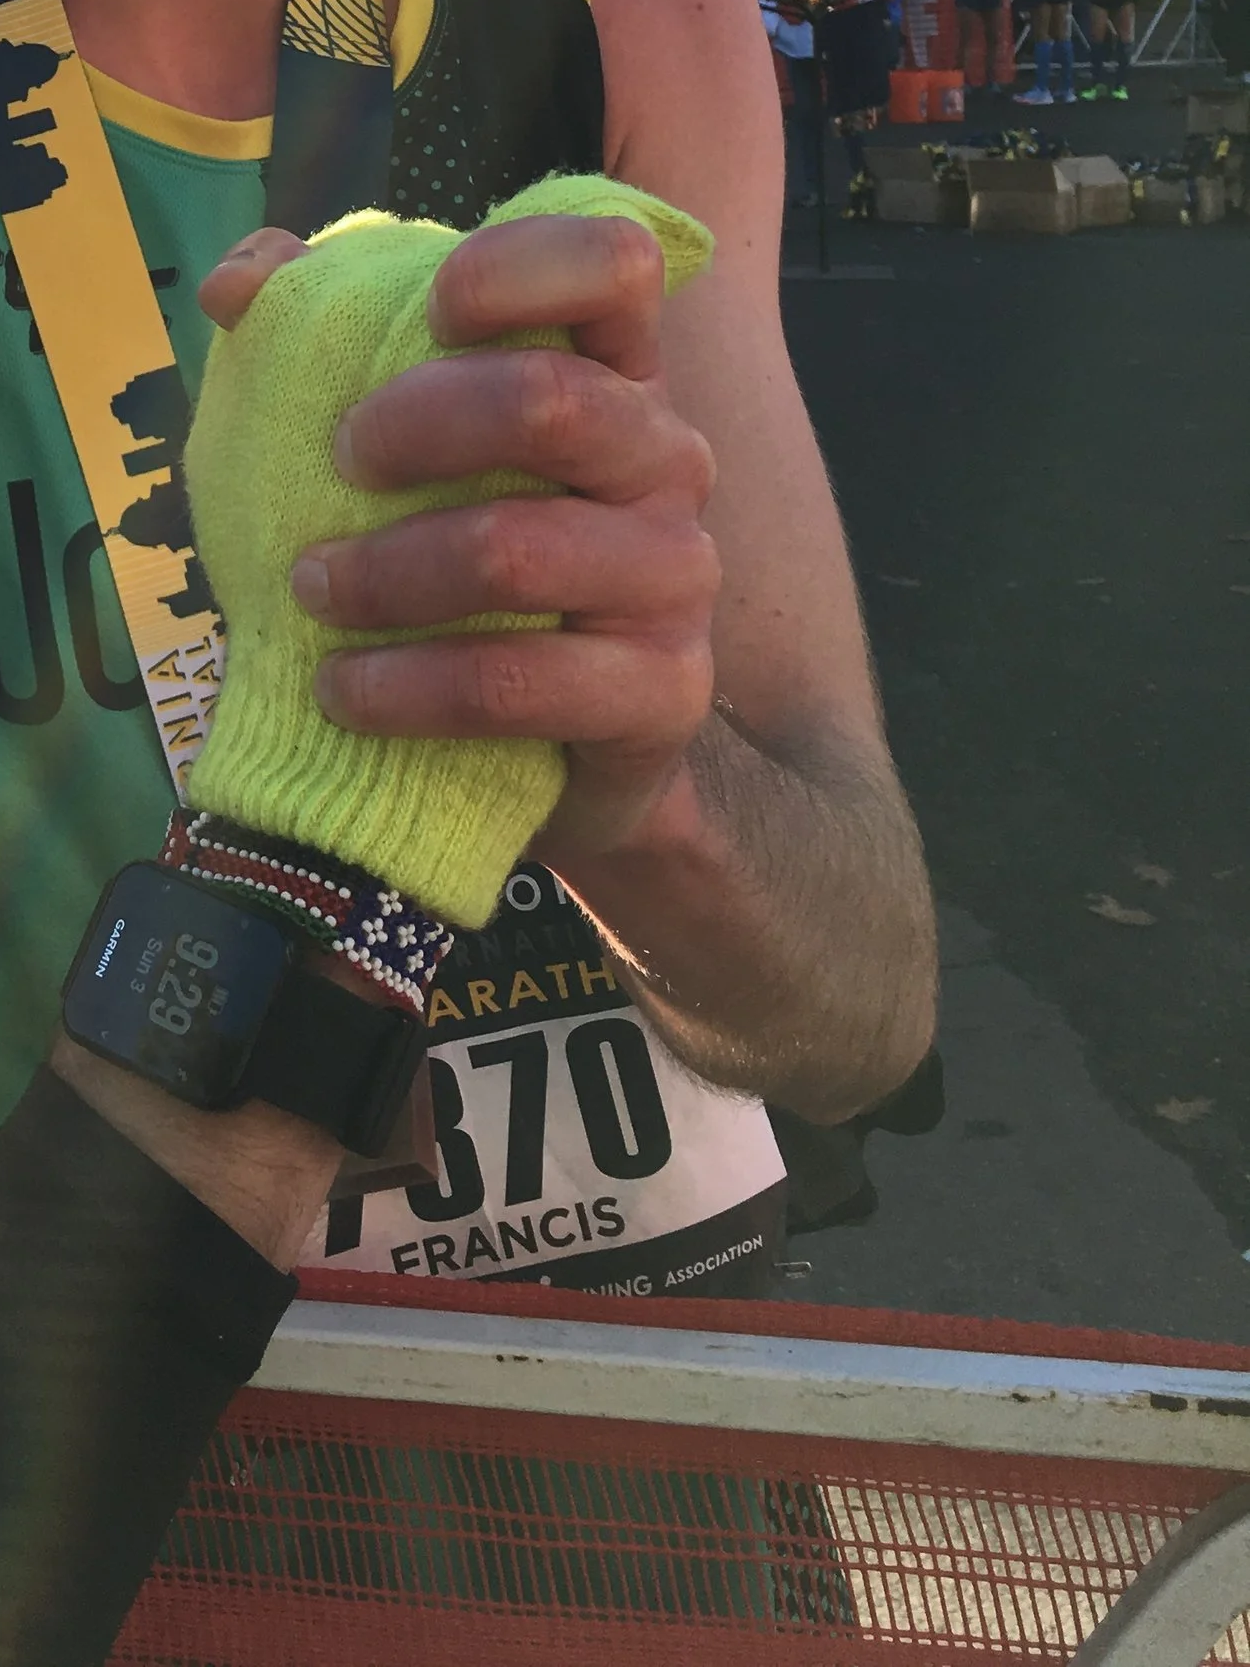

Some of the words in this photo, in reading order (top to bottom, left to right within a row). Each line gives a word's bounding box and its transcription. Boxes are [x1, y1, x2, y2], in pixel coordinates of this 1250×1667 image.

[95, 918, 126, 979] GARMIN
[135, 937, 164, 975] Sun
[427, 956, 618, 1028] ARATH
[391, 1196, 626, 1276] FRANCIS
[664, 1234, 764, 1289] ASSOCIATION
